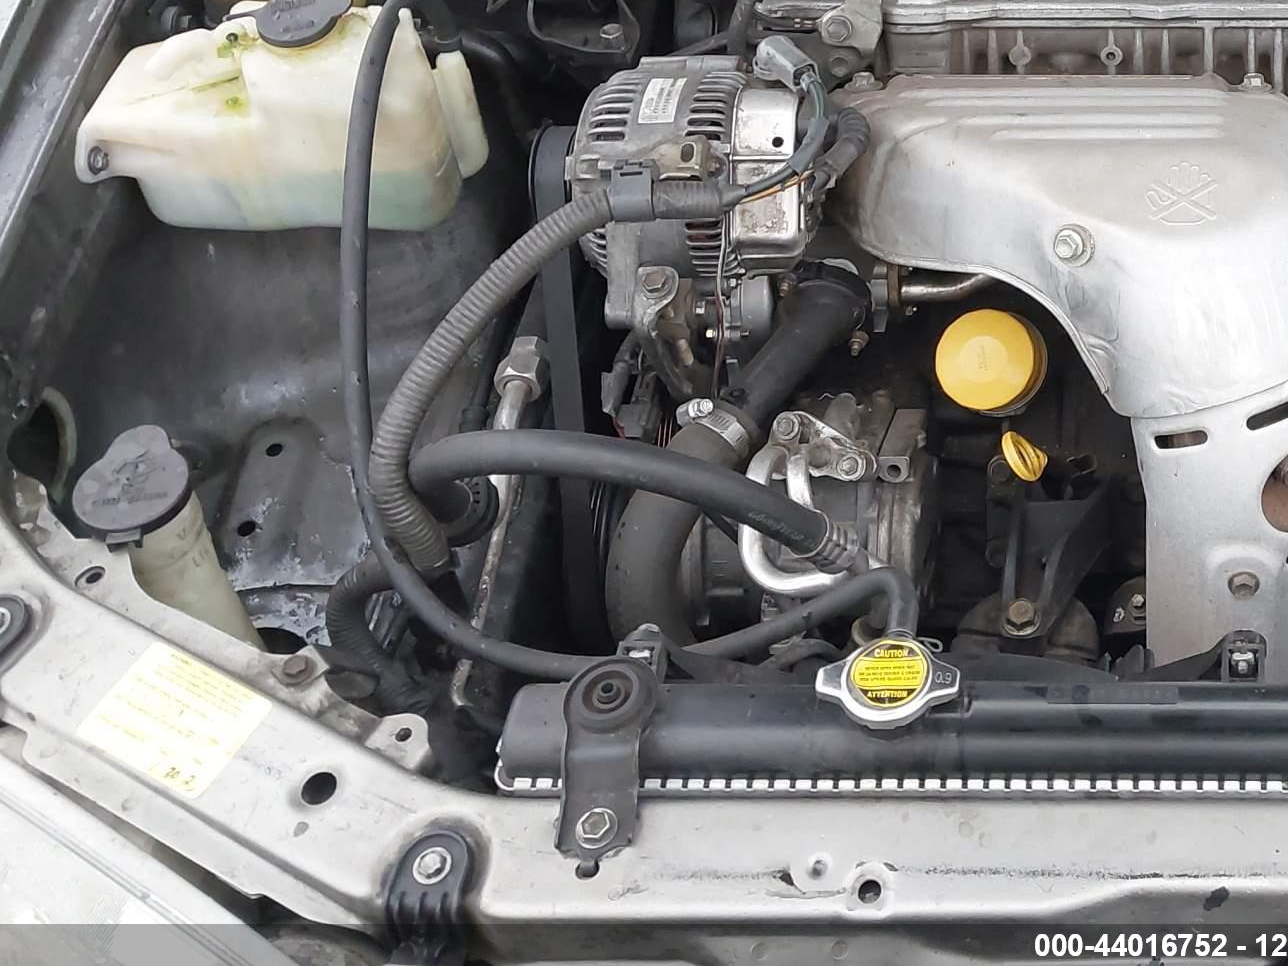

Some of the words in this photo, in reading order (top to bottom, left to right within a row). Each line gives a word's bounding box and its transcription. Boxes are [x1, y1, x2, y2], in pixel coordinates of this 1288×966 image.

[874, 648, 910, 658] CAUTION
[934, 671, 952, 683] 0.9
[867, 690, 908, 699] ATTENTION
